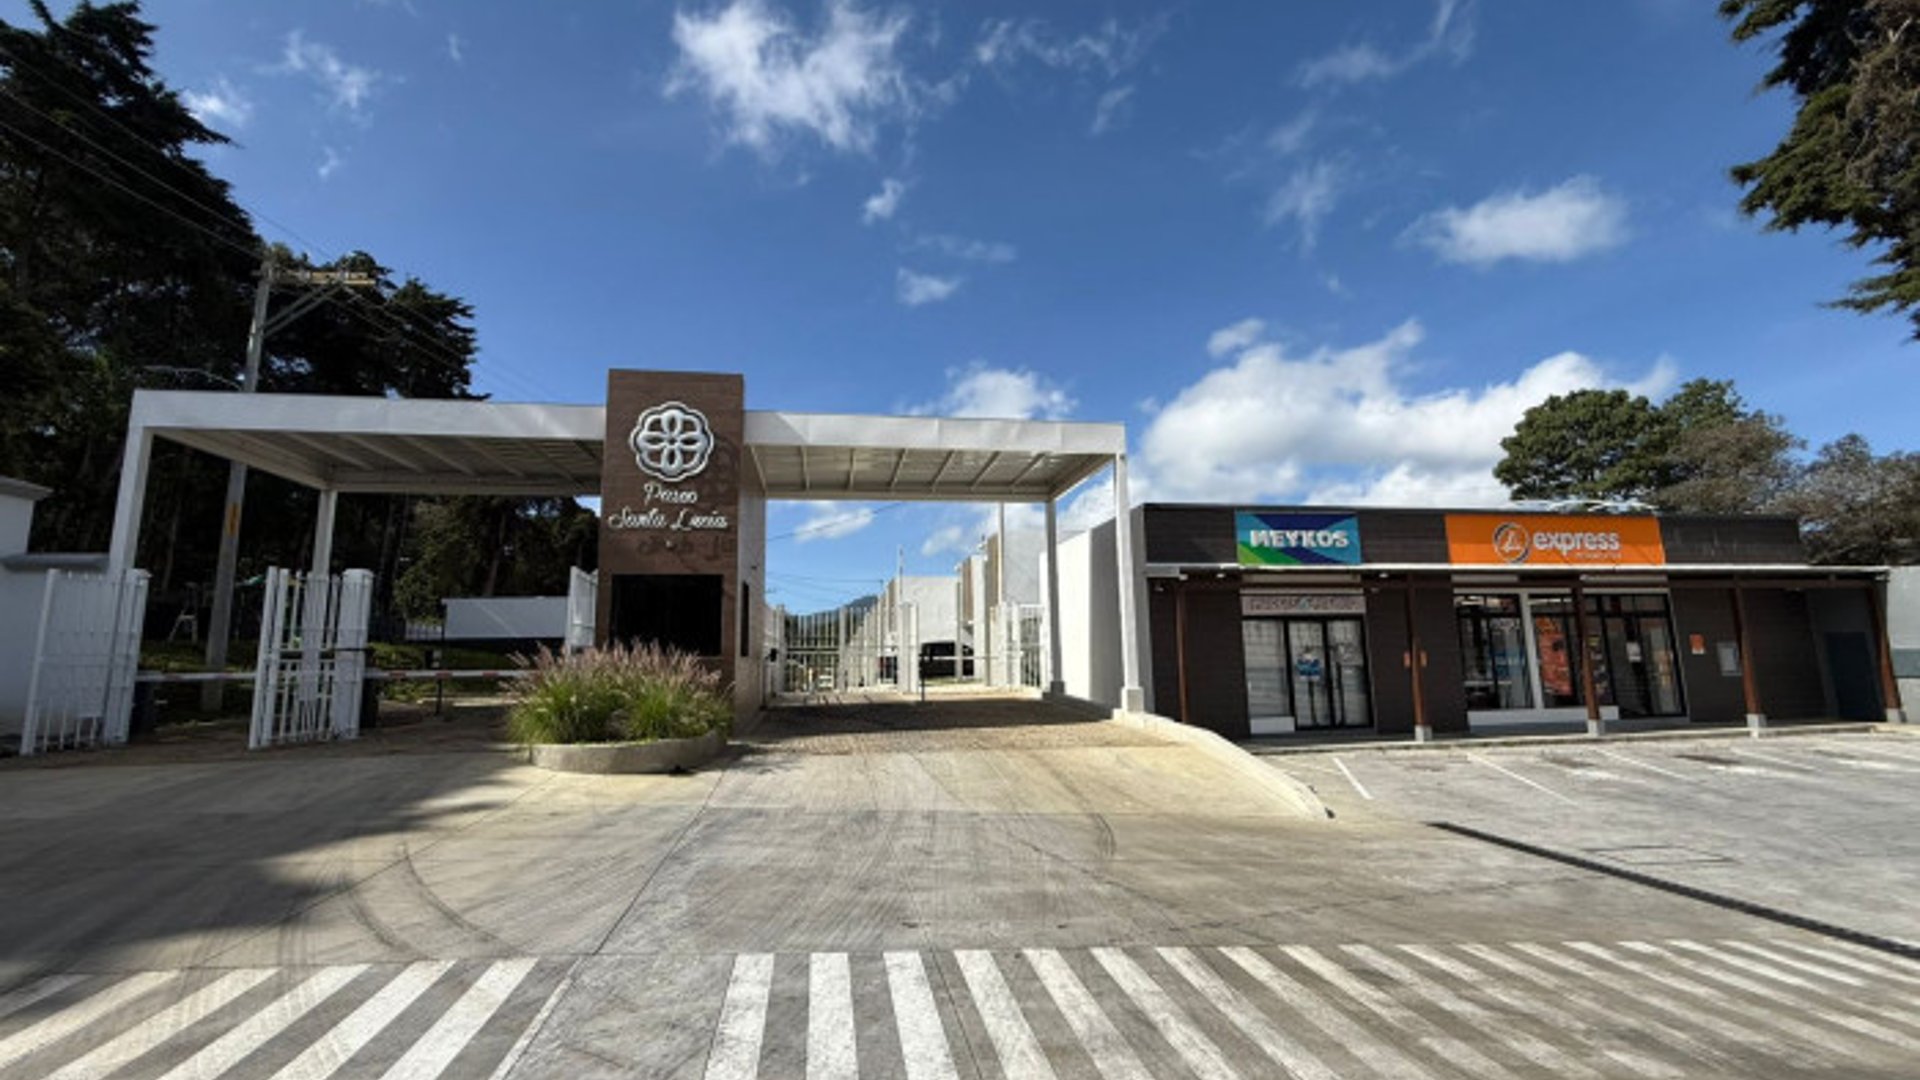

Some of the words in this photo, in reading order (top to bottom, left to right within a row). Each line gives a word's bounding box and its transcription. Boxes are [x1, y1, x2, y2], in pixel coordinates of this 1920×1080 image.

[644, 482, 698, 505] Paseo
[608, 506, 666, 528] Santa
[1533, 532, 1620, 556] express
